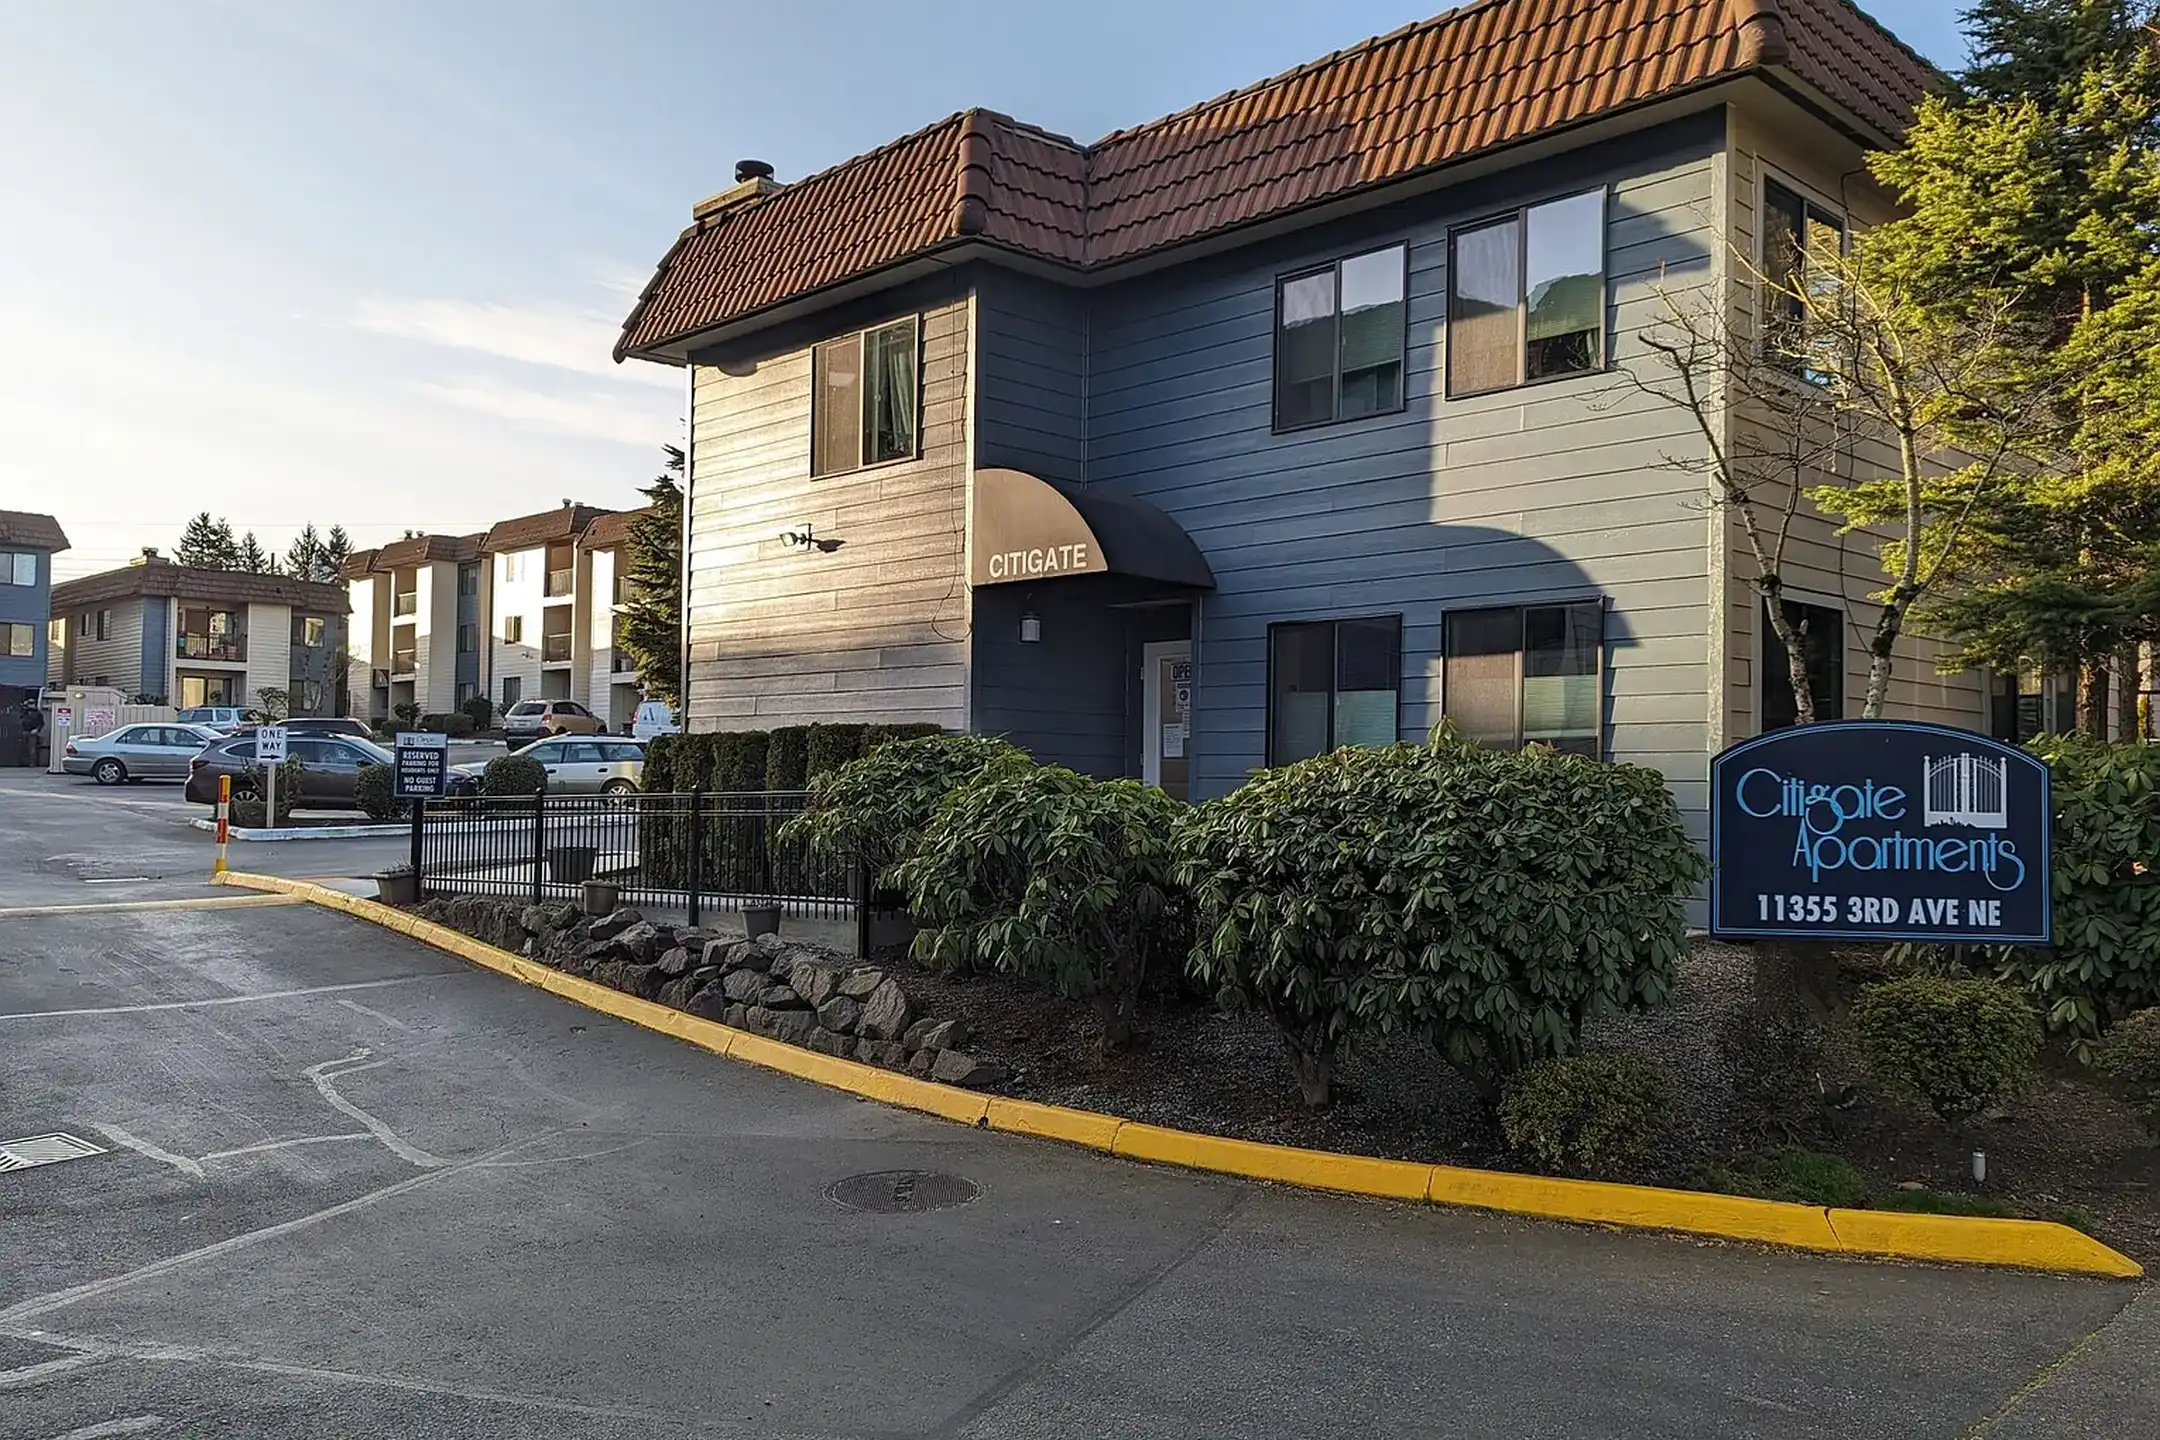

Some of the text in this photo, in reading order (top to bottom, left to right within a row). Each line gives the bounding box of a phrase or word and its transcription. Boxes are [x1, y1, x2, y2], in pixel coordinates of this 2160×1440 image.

[989, 543, 1088, 578] CITIGATE
[1173, 664, 1191, 679] OPE
[261, 729, 282, 739] ONE
[261, 741, 282, 750] WAY
[402, 751, 440, 760] RESERVED
[403, 776, 436, 785] NO GUEST
[404, 784, 435, 792] PARKING
[1736, 768, 1907, 836] Citigate
[1792, 816, 2026, 892] Apartments
[1757, 894, 2002, 927] 11355 3RD AVE NE
